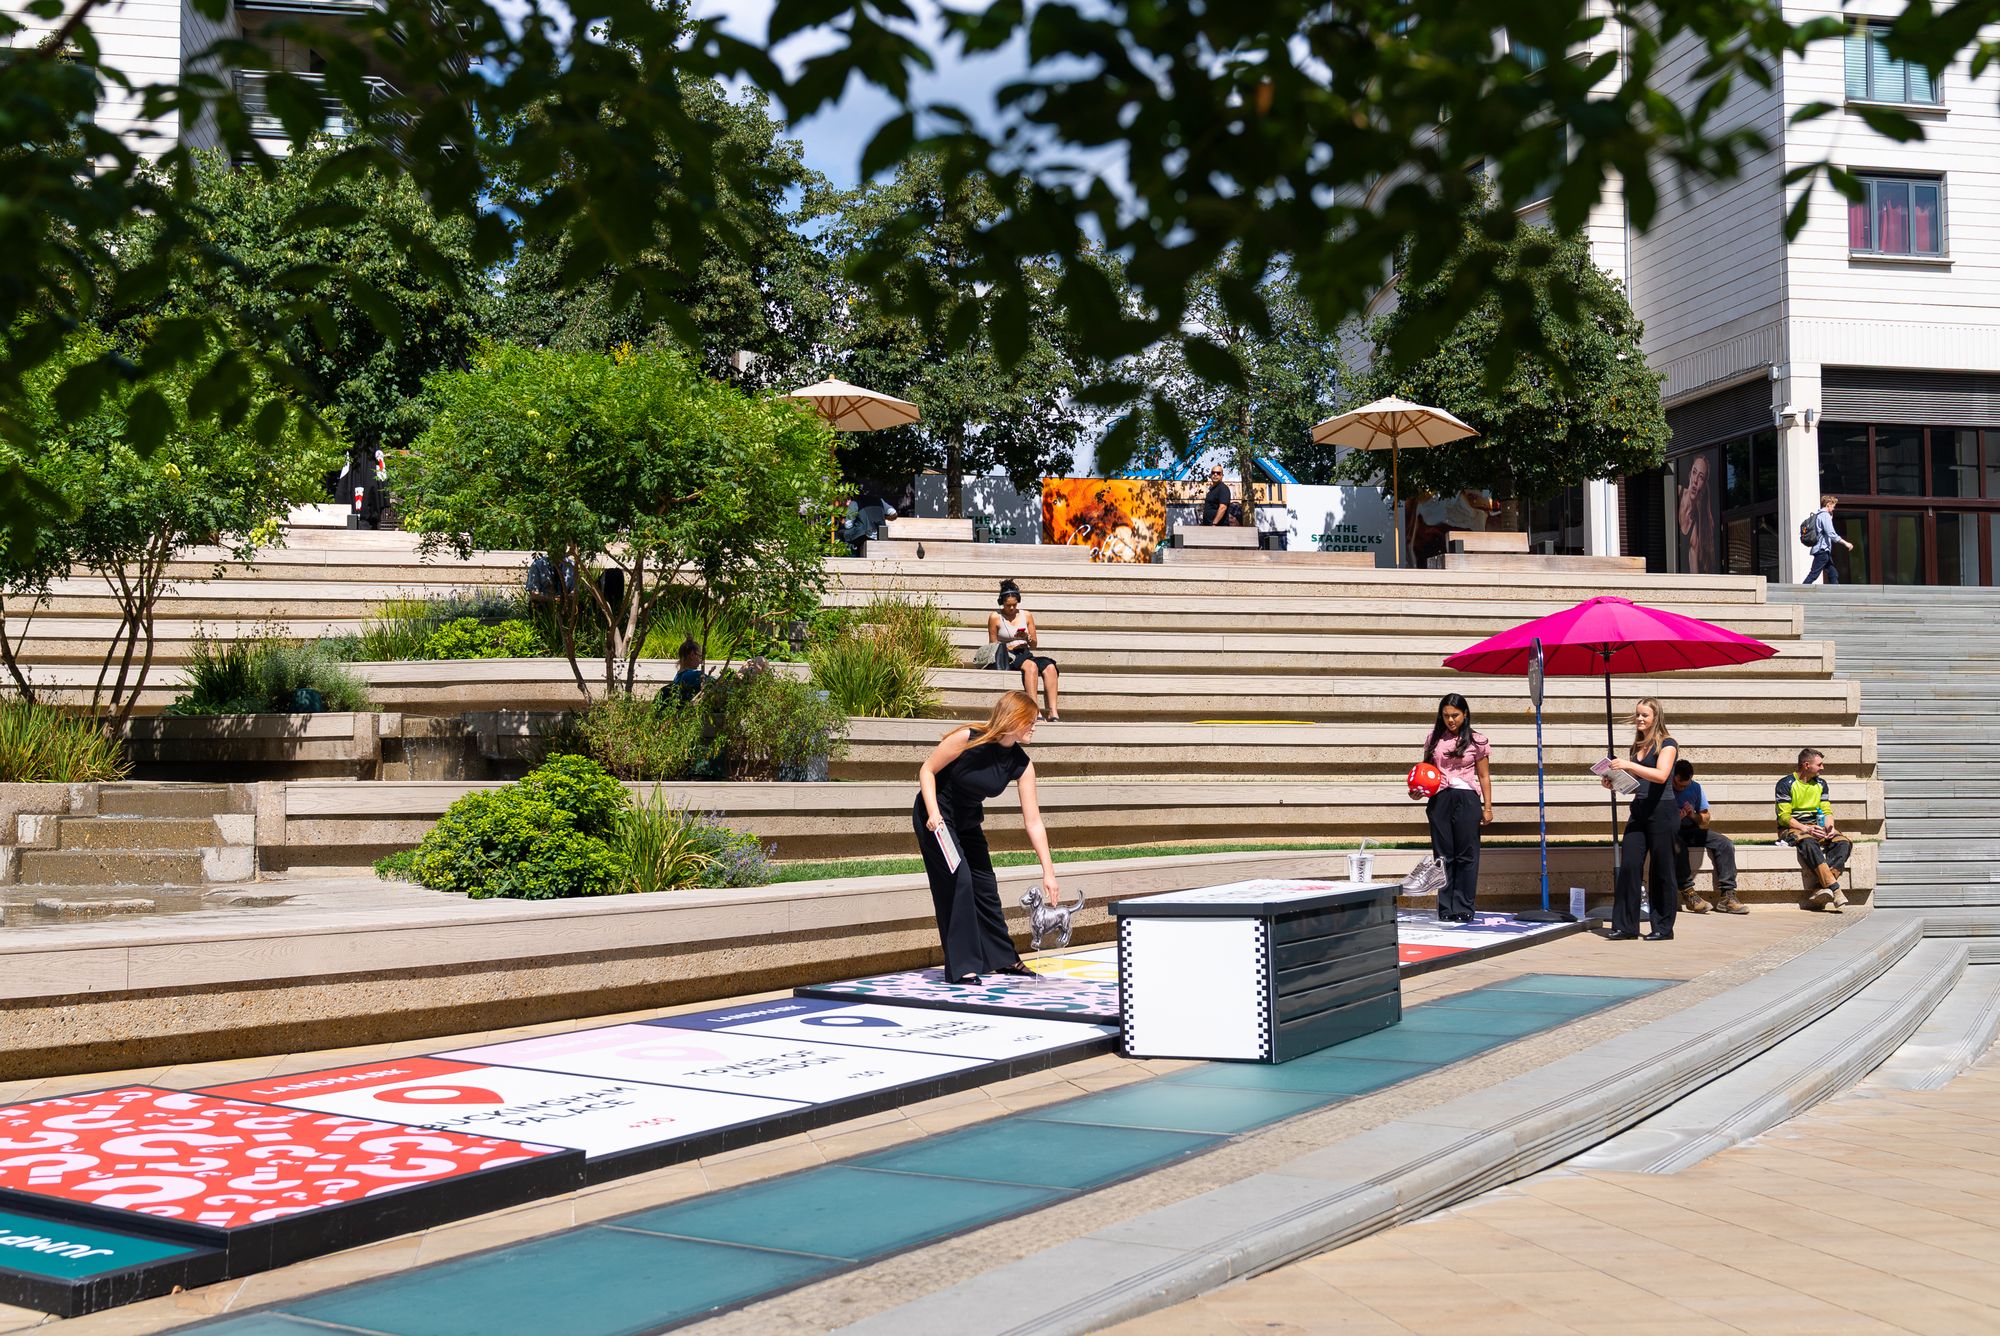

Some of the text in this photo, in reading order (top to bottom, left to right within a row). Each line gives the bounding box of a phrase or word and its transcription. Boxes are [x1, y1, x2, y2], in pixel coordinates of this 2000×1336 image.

[1336, 525, 1358, 533] THE
[1311, 534, 1382, 544] STARBUCKS
[706, 1005, 807, 1022] LANDMARK
[882, 1021, 973, 1038] CANADA
[920, 1025, 998, 1039] WATER
[682, 1050, 815, 1077] TOWER OF
[731, 1056, 845, 1079] LONDON
[251, 1069, 412, 1095] LANDMARK
[421, 1086, 638, 1131] BUCKINGHAM
[501, 1099, 635, 1127] PALACE
[629, 1117, 676, 1129] +30
